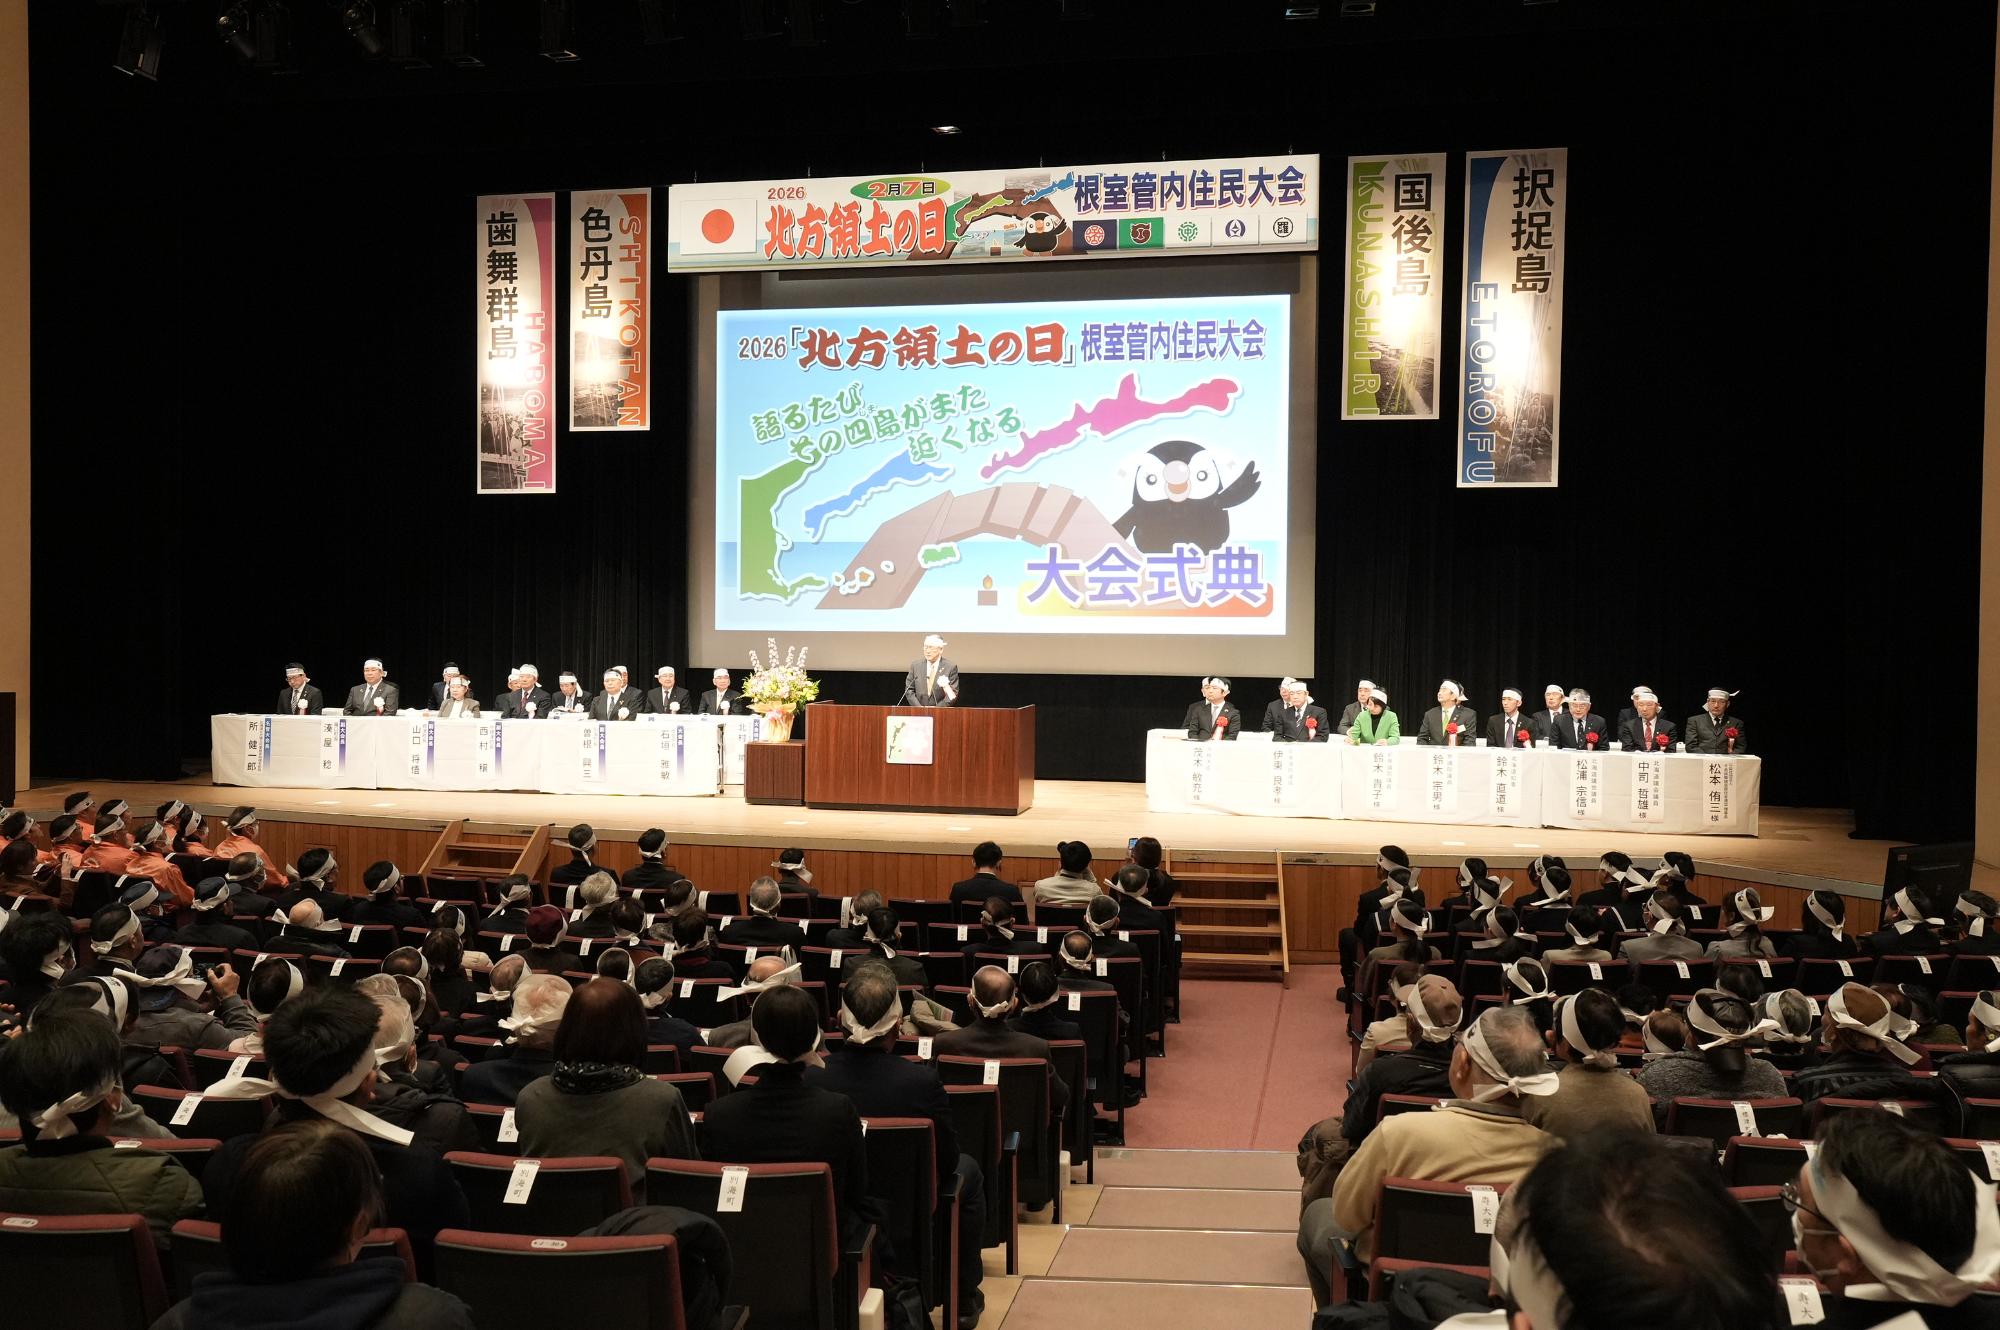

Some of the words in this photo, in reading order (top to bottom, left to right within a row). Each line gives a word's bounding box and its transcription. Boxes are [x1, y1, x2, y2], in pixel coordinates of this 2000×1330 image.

[767, 186, 806, 200] 2026
[868, 180, 936, 198] 2月7日
[1073, 165, 1307, 214] 根室管内住民大会
[580, 207, 613, 320] 色丹島
[763, 197, 948, 260] 北方領土の日
[1391, 173, 1432, 297] 国後島
[1511, 167, 1555, 294] 択捉島
[486, 211, 519, 361] 歯舞群島
[617, 215, 642, 427] SHIKOTAN
[1352, 174, 1385, 417] KUNASHIRI
[738, 337, 787, 361] 2026
[1081, 319, 1267, 362] 根室管内住民大会
[522, 311, 546, 490] HABOMAI
[753, 383, 862, 442] 語るたび
[1466, 281, 1499, 484] ETOROFU
[790, 385, 986, 462] その四島がまた
[909, 407, 1022, 462] 近くなる
[1026, 545, 1266, 606] 大会式典
